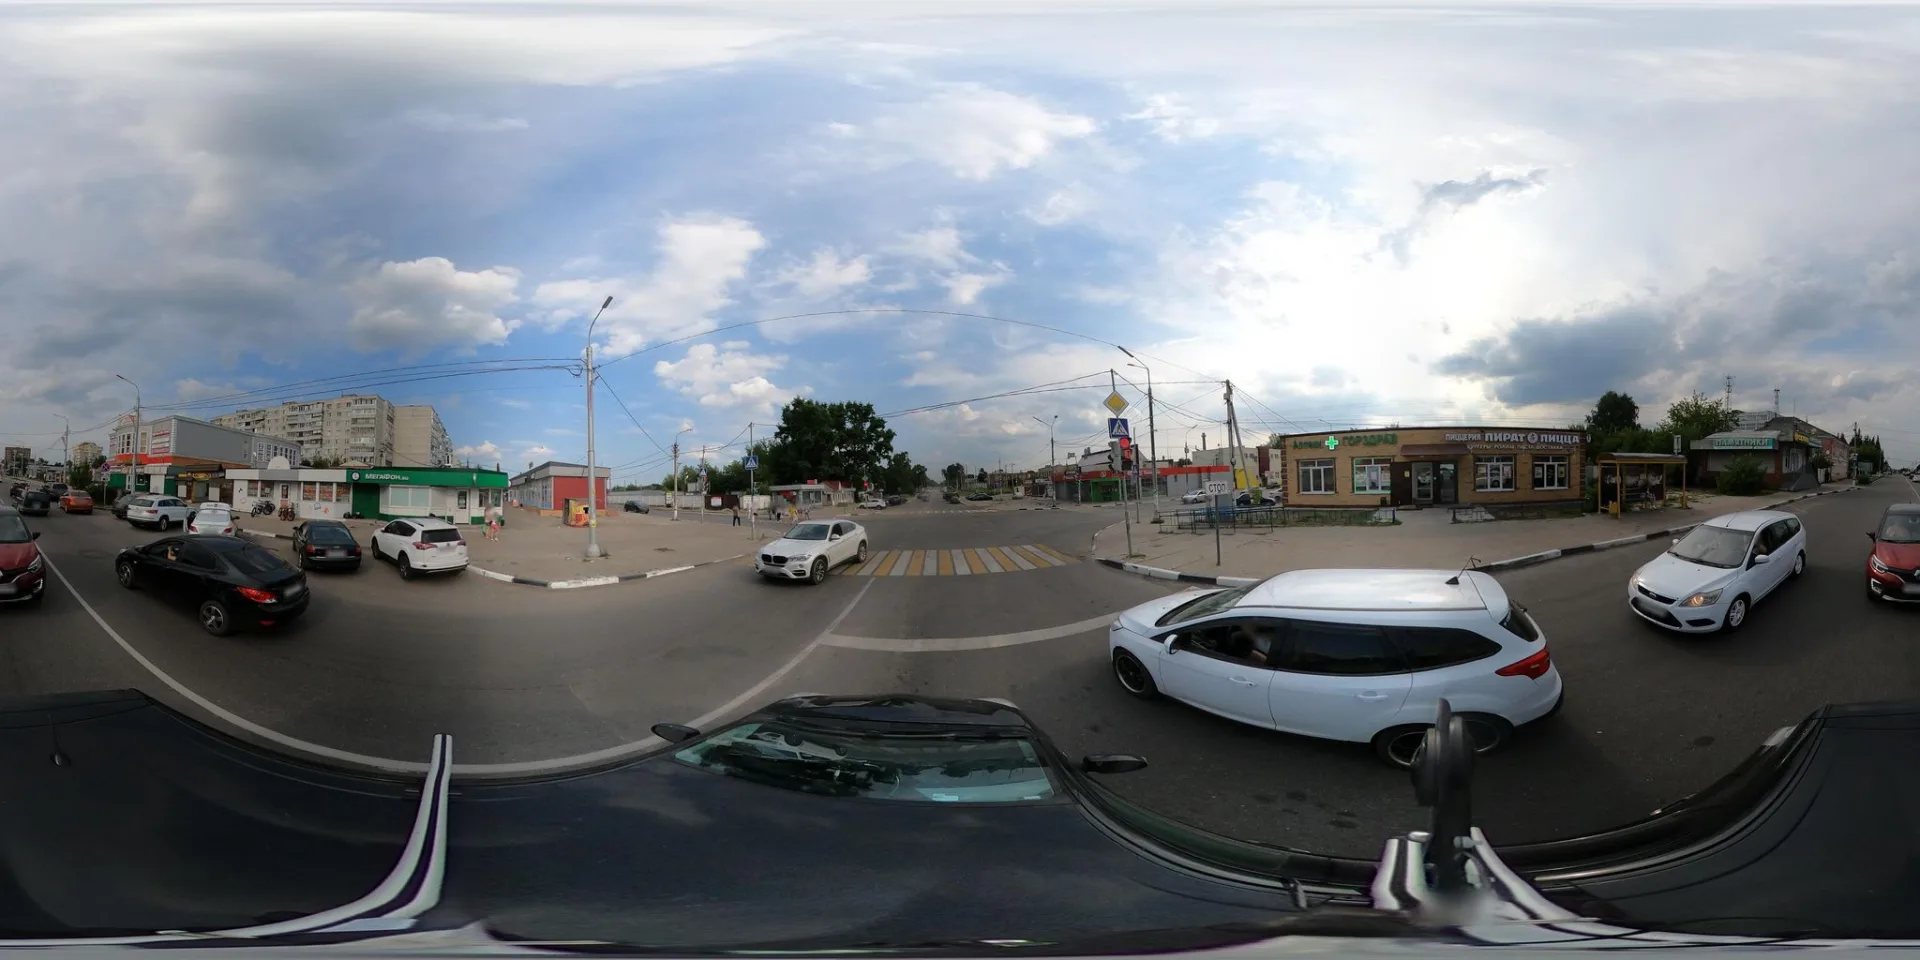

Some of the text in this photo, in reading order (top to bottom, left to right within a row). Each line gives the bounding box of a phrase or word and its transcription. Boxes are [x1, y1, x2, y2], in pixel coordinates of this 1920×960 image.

[1485, 432, 1525, 442] ПИРАТ
[1541, 434, 1580, 444] ПИЦЦА
[1715, 438, 1769, 447] ПАМЯТНИКИ
[1209, 483, 1226, 493] СТОП
